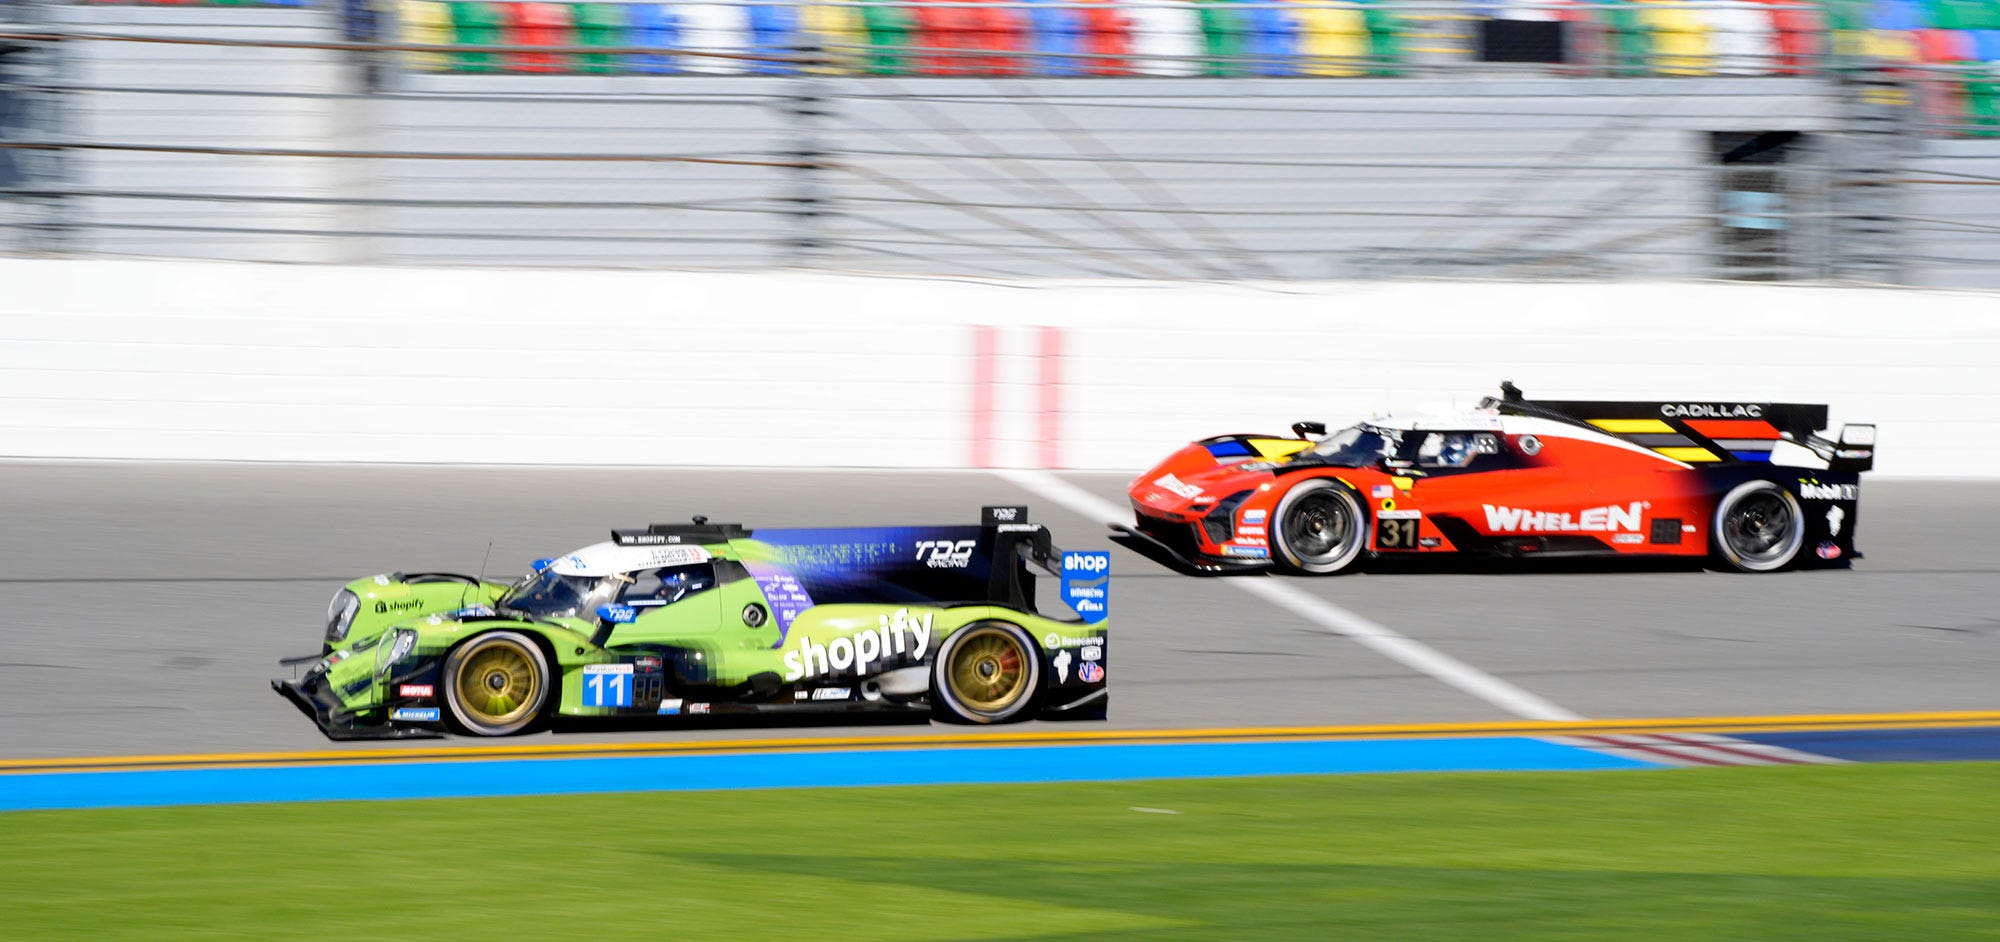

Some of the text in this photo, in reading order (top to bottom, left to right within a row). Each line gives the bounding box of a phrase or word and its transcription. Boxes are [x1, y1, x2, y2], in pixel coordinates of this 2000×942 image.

[1660, 404, 1762, 418] CADILLAC
[1482, 501, 1643, 531] WHELEN
[1380, 519, 1415, 547] 31
[915, 540, 976, 561] TDS
[1064, 553, 1108, 573] shop
[389, 599, 424, 611] shopify
[783, 608, 933, 682] shopify
[401, 685, 432, 697] MOTUL
[588, 674, 624, 706] 11
[402, 711, 435, 719] MICHELIN
